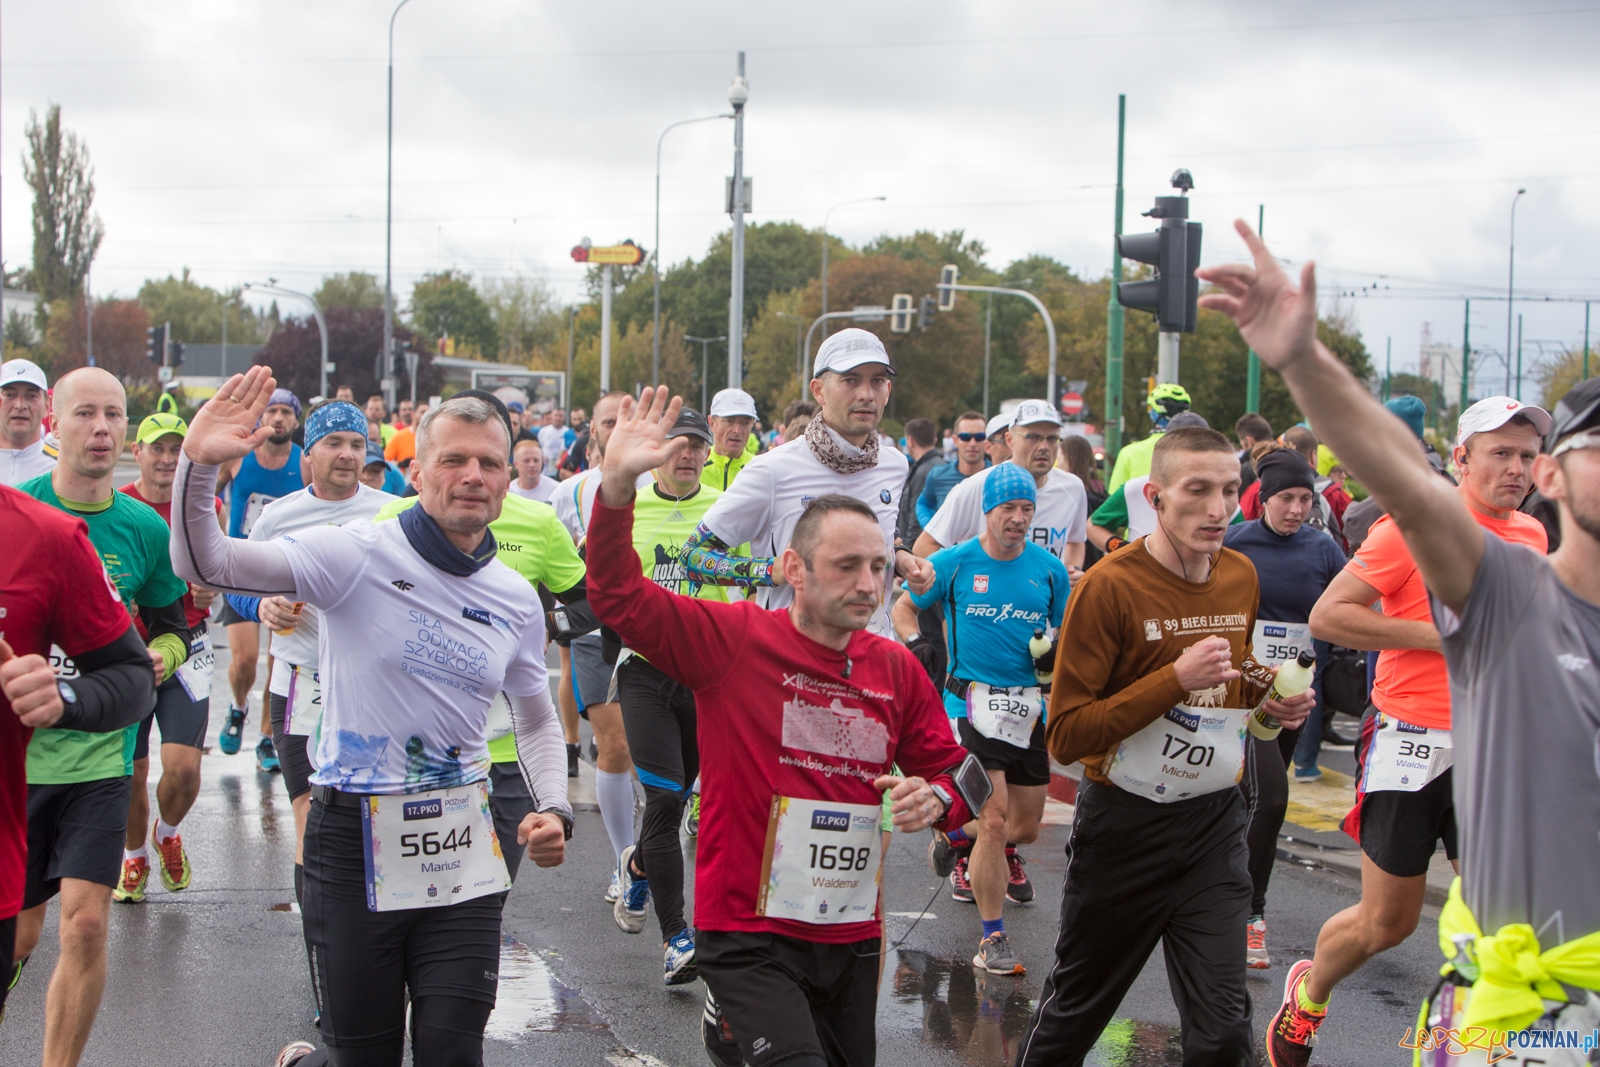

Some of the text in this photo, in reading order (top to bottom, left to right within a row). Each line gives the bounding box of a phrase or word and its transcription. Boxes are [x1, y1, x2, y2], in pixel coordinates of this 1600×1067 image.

[497, 541, 523, 552] ktor
[409, 609, 443, 633] SIŁA
[965, 607, 998, 617] PRO
[1011, 609, 1043, 621] RUN
[1164, 619, 1178, 631] 39
[1181, 616, 1207, 629] BIEG
[1208, 612, 1247, 627] LECHITÓW
[417, 628, 489, 664] ODWAGA
[401, 662, 408, 671] 9
[404, 639, 488, 680] SZYBKOŚĆ
[782, 672, 803, 690] XII
[988, 698, 1030, 718] 6328
[1161, 733, 1215, 767] 1701
[1398, 740, 1445, 760] 38
[1161, 763, 1200, 780] Michał
[406, 804, 440, 816] 17.PKO
[815, 815, 848, 827] 17.PKO
[400, 825, 473, 858] 5644
[421, 860, 461, 873] Mariusz
[809, 843, 871, 872] 1698
[811, 876, 860, 889] Waldemar
